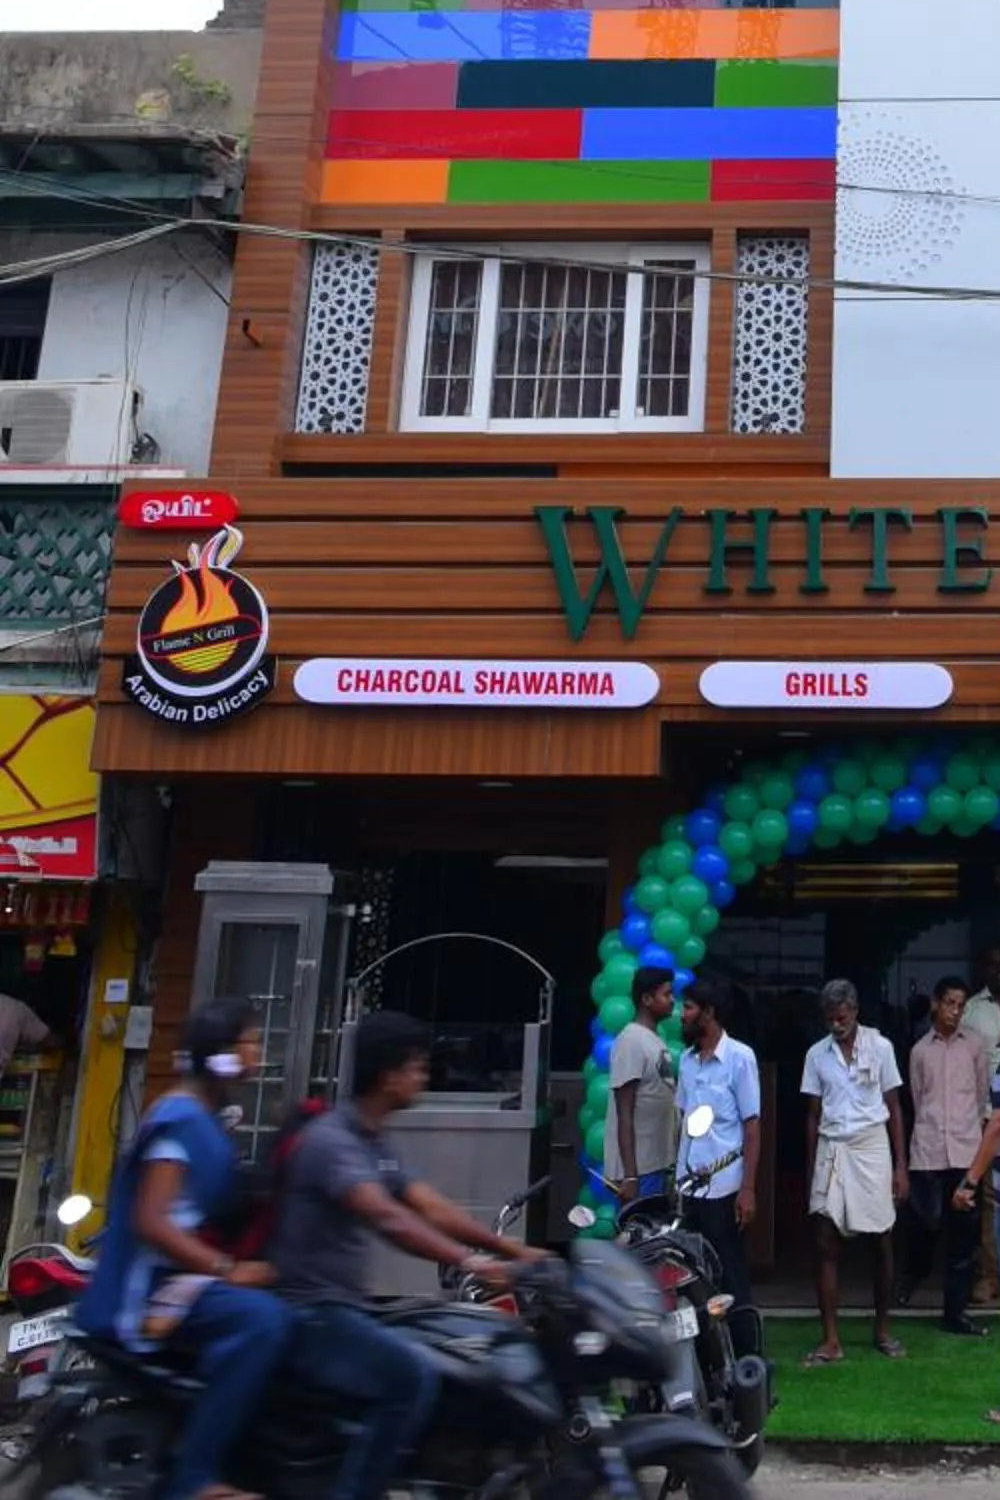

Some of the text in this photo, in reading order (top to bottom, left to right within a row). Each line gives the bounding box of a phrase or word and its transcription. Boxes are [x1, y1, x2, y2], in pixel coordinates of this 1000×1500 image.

[533, 505, 992, 641] WHITE
[153, 637, 191, 652] Flame
[207, 624, 235, 641] Grill
[126, 669, 268, 722] Arabian Delicacy
[337, 668, 615, 696] CHARCOAL SHAWARMA
[785, 672, 868, 697] GRILLS
